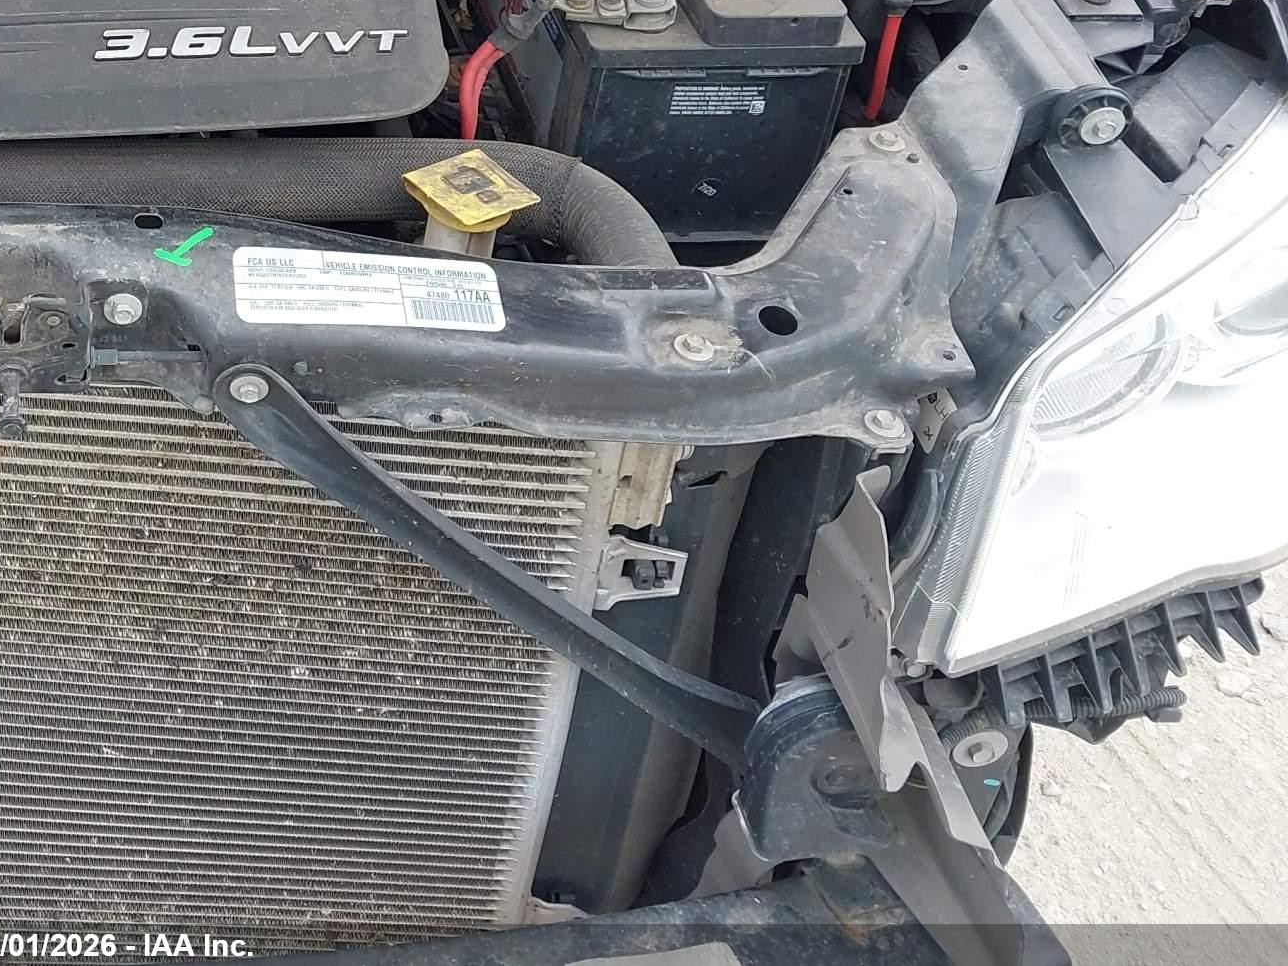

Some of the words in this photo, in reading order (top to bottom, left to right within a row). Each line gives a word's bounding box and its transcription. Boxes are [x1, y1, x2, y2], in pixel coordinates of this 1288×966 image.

[247, 257, 263, 266] FCA
[266, 258, 277, 266] US
[279, 258, 294, 267] LLC
[326, 261, 357, 270] VEHICLE
[359, 262, 396, 273] EMISSION
[397, 265, 433, 276] CONTROL
[434, 269, 487, 280] INFORMATION
[453, 289, 491, 303] 117AA
